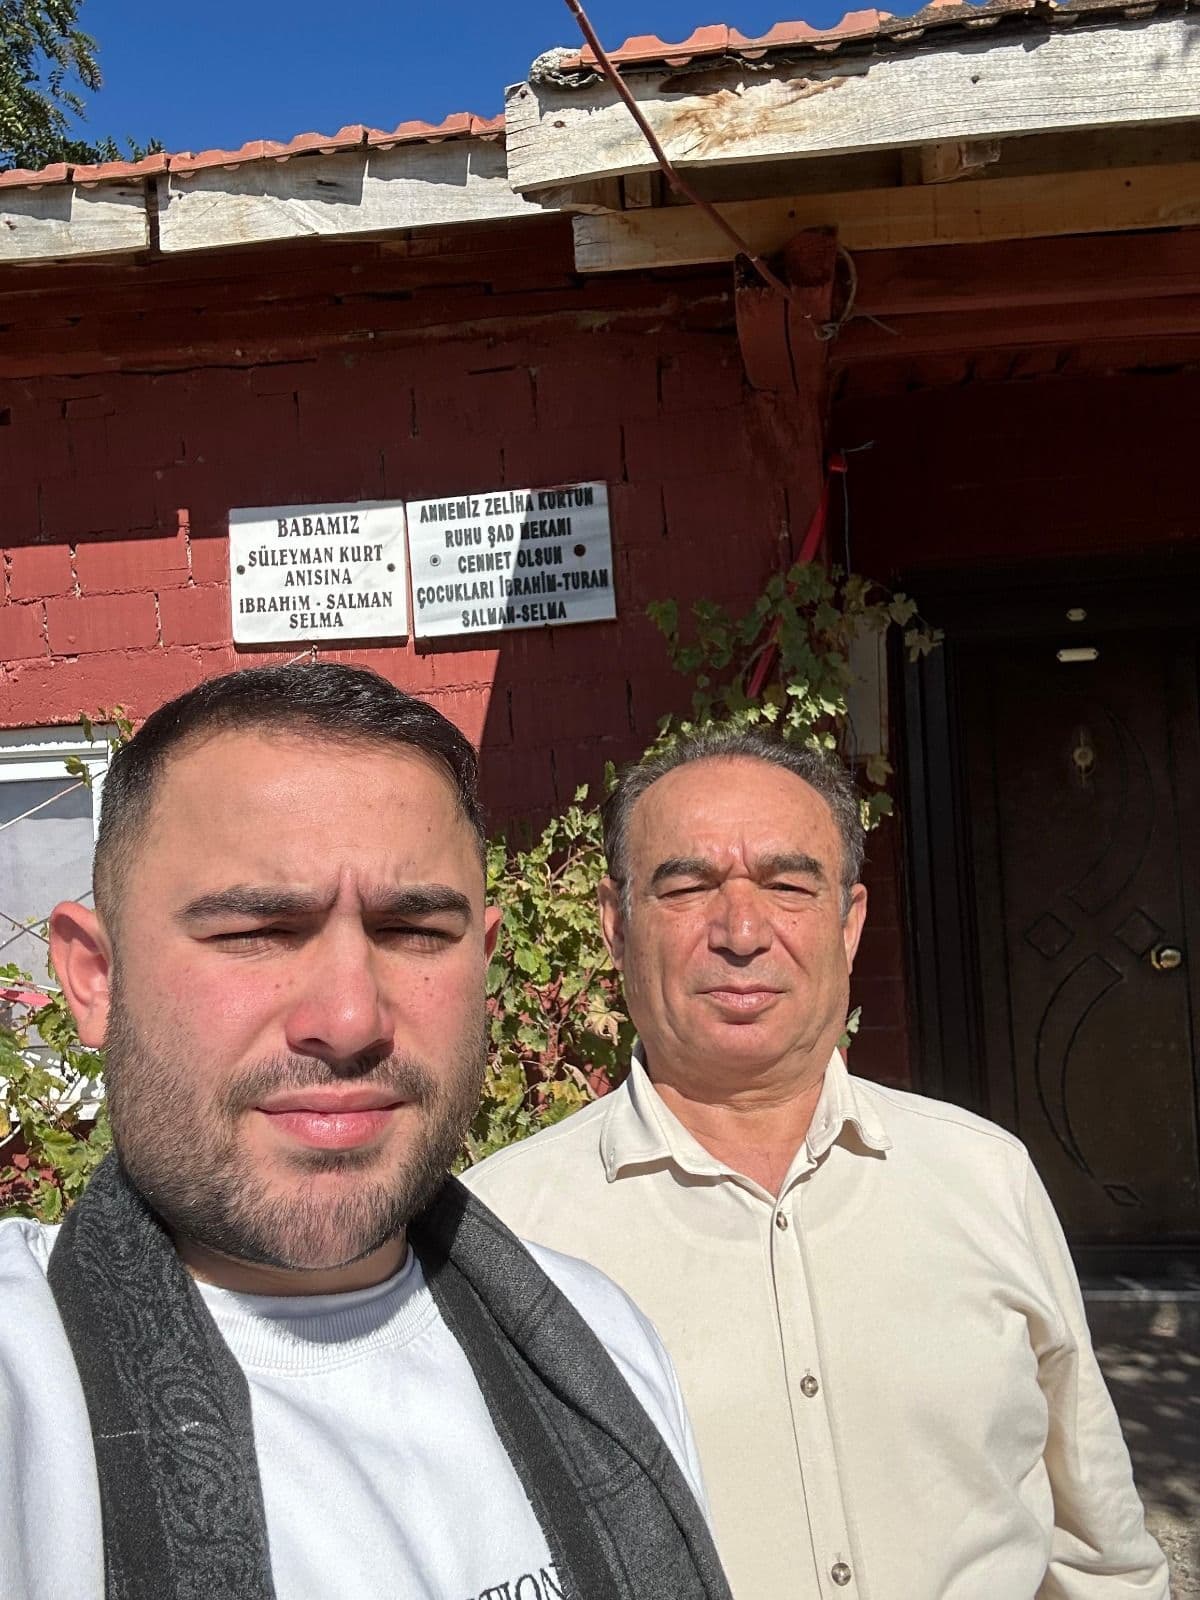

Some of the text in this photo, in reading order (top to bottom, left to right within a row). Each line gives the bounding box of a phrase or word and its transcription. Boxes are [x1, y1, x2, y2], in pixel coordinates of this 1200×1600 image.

[419, 496, 481, 523] ANNEMİZ
[485, 492, 534, 516] ZELİHA
[277, 515, 360, 537] BABAMIZ
[445, 517, 571, 548] RUHU ŞAD MEKANI
[248, 544, 383, 567] SÜLEYMAN KURT
[458, 546, 563, 574] CENNET OLSUN
[326, 591, 393, 610] SALMAN
[417, 580, 494, 609] ÇOCUKLARI
[289, 612, 344, 629] SELMA
